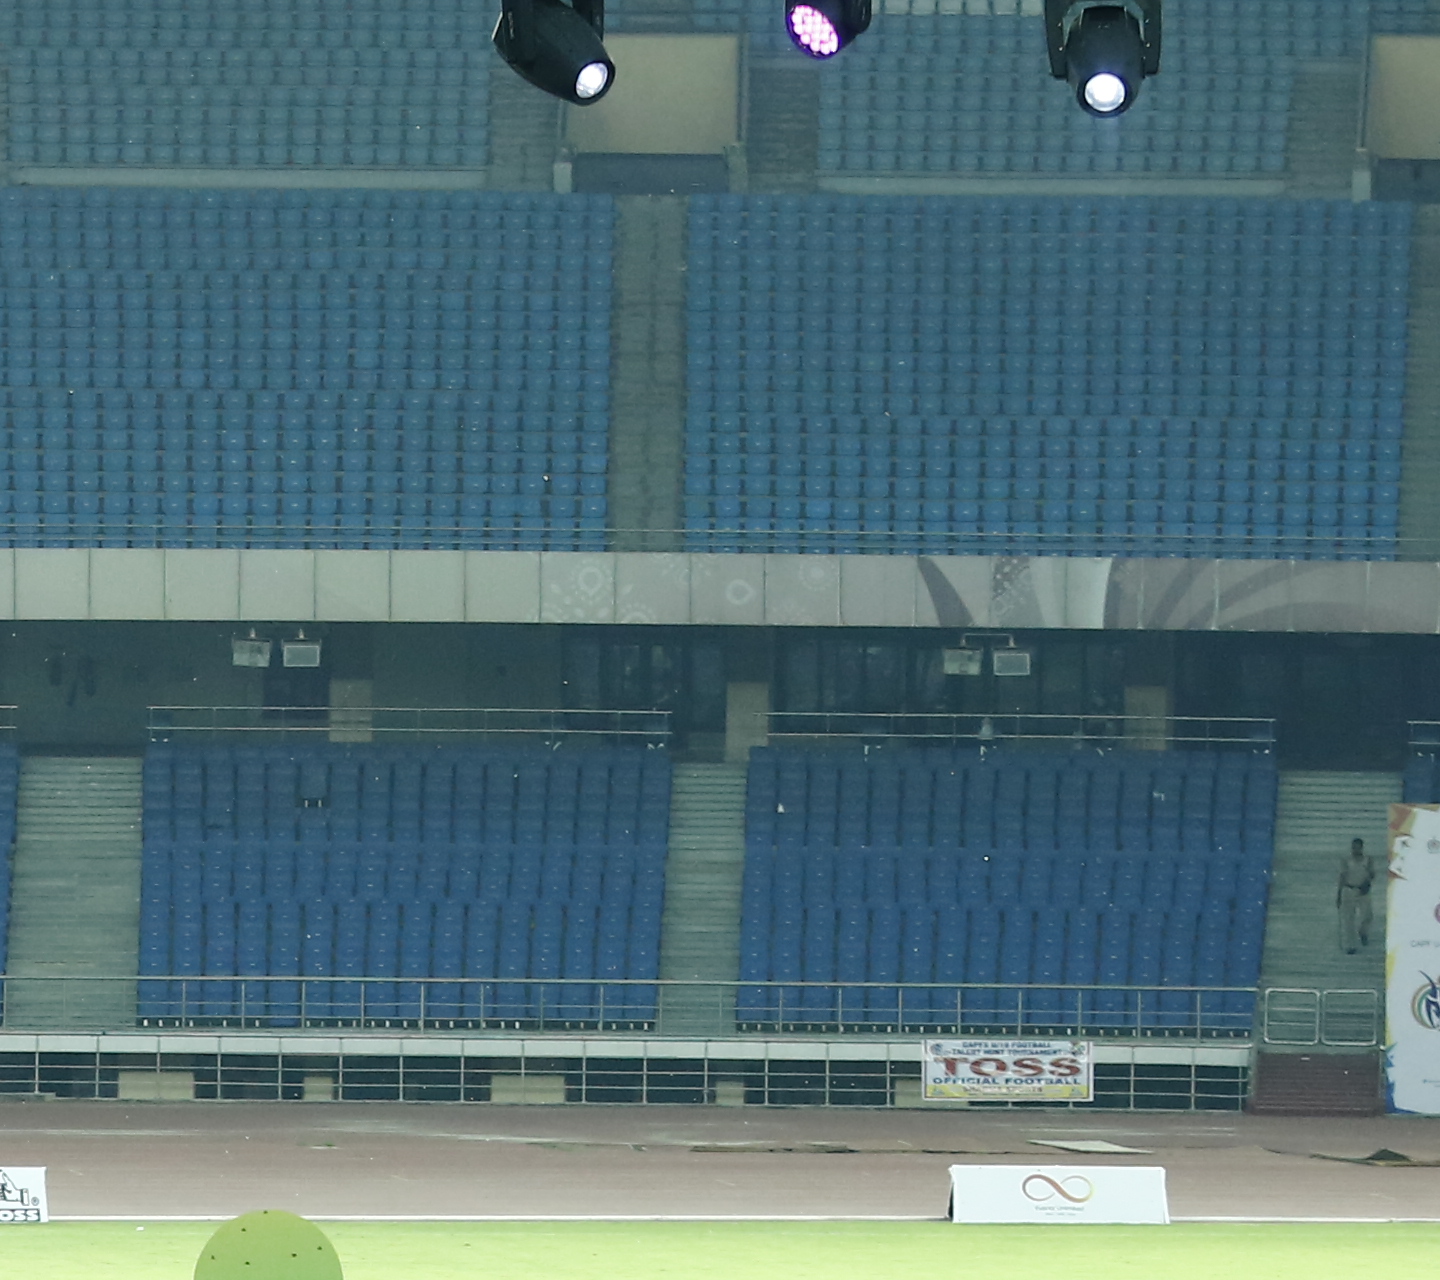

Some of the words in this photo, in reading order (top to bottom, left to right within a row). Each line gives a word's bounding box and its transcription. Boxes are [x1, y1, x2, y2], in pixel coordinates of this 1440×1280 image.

[933, 1057, 1081, 1077] TOSS
[933, 1077, 999, 1085] OFFICIAL
[1005, 1077, 1081, 1085] FOOTBALL
